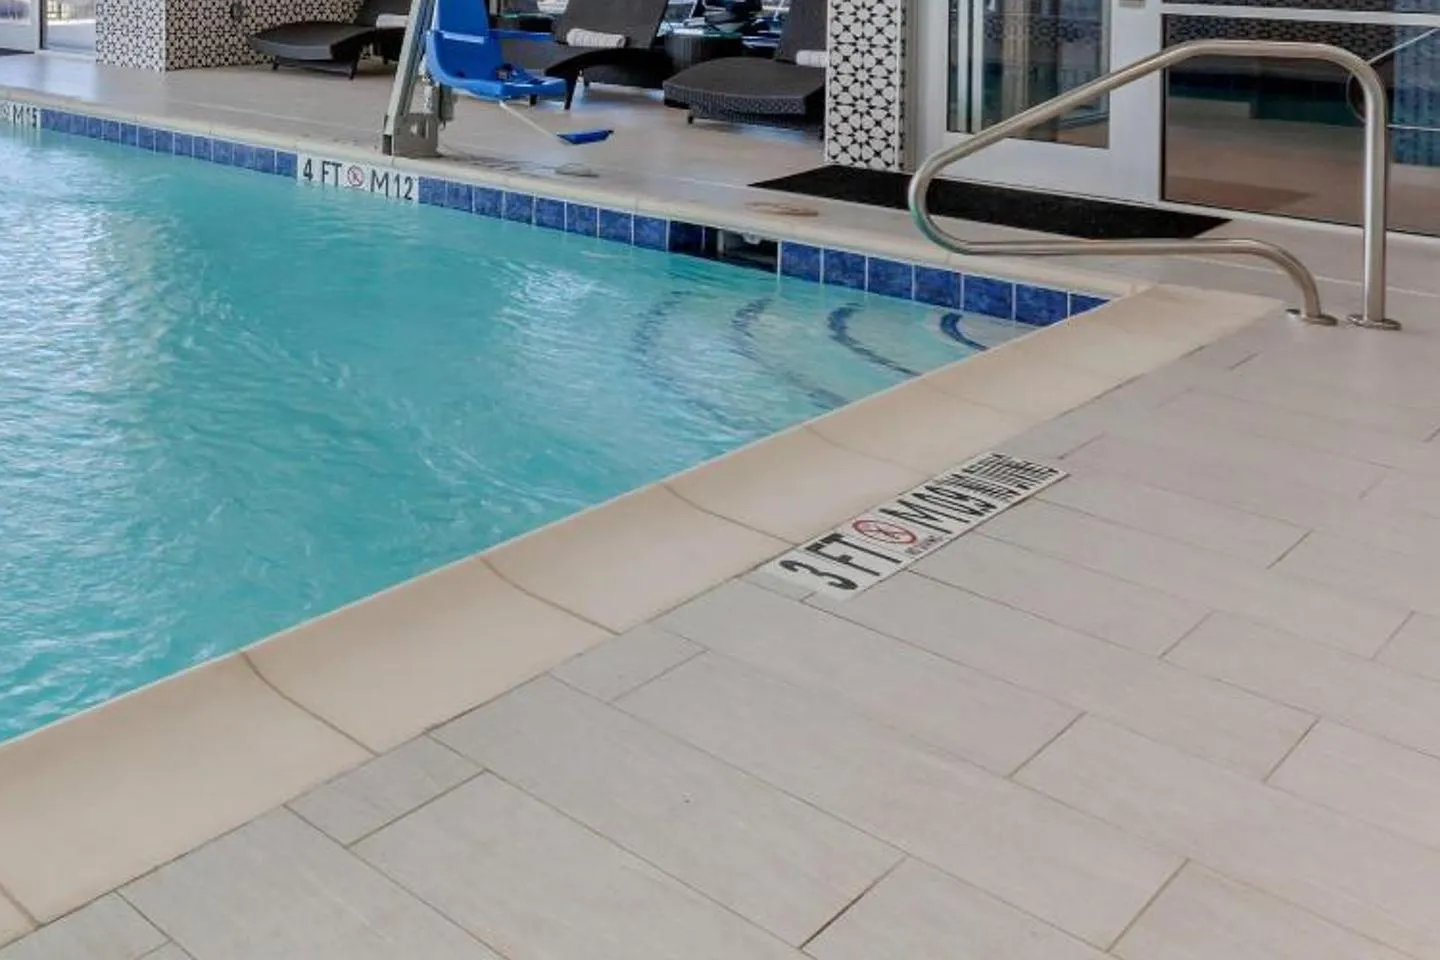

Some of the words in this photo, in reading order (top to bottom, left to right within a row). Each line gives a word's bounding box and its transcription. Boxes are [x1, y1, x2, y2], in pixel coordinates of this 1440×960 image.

[303, 158, 314, 181] 4
[321, 160, 342, 188] FT
[806, 533, 903, 577] FT
[779, 559, 858, 590] 3
